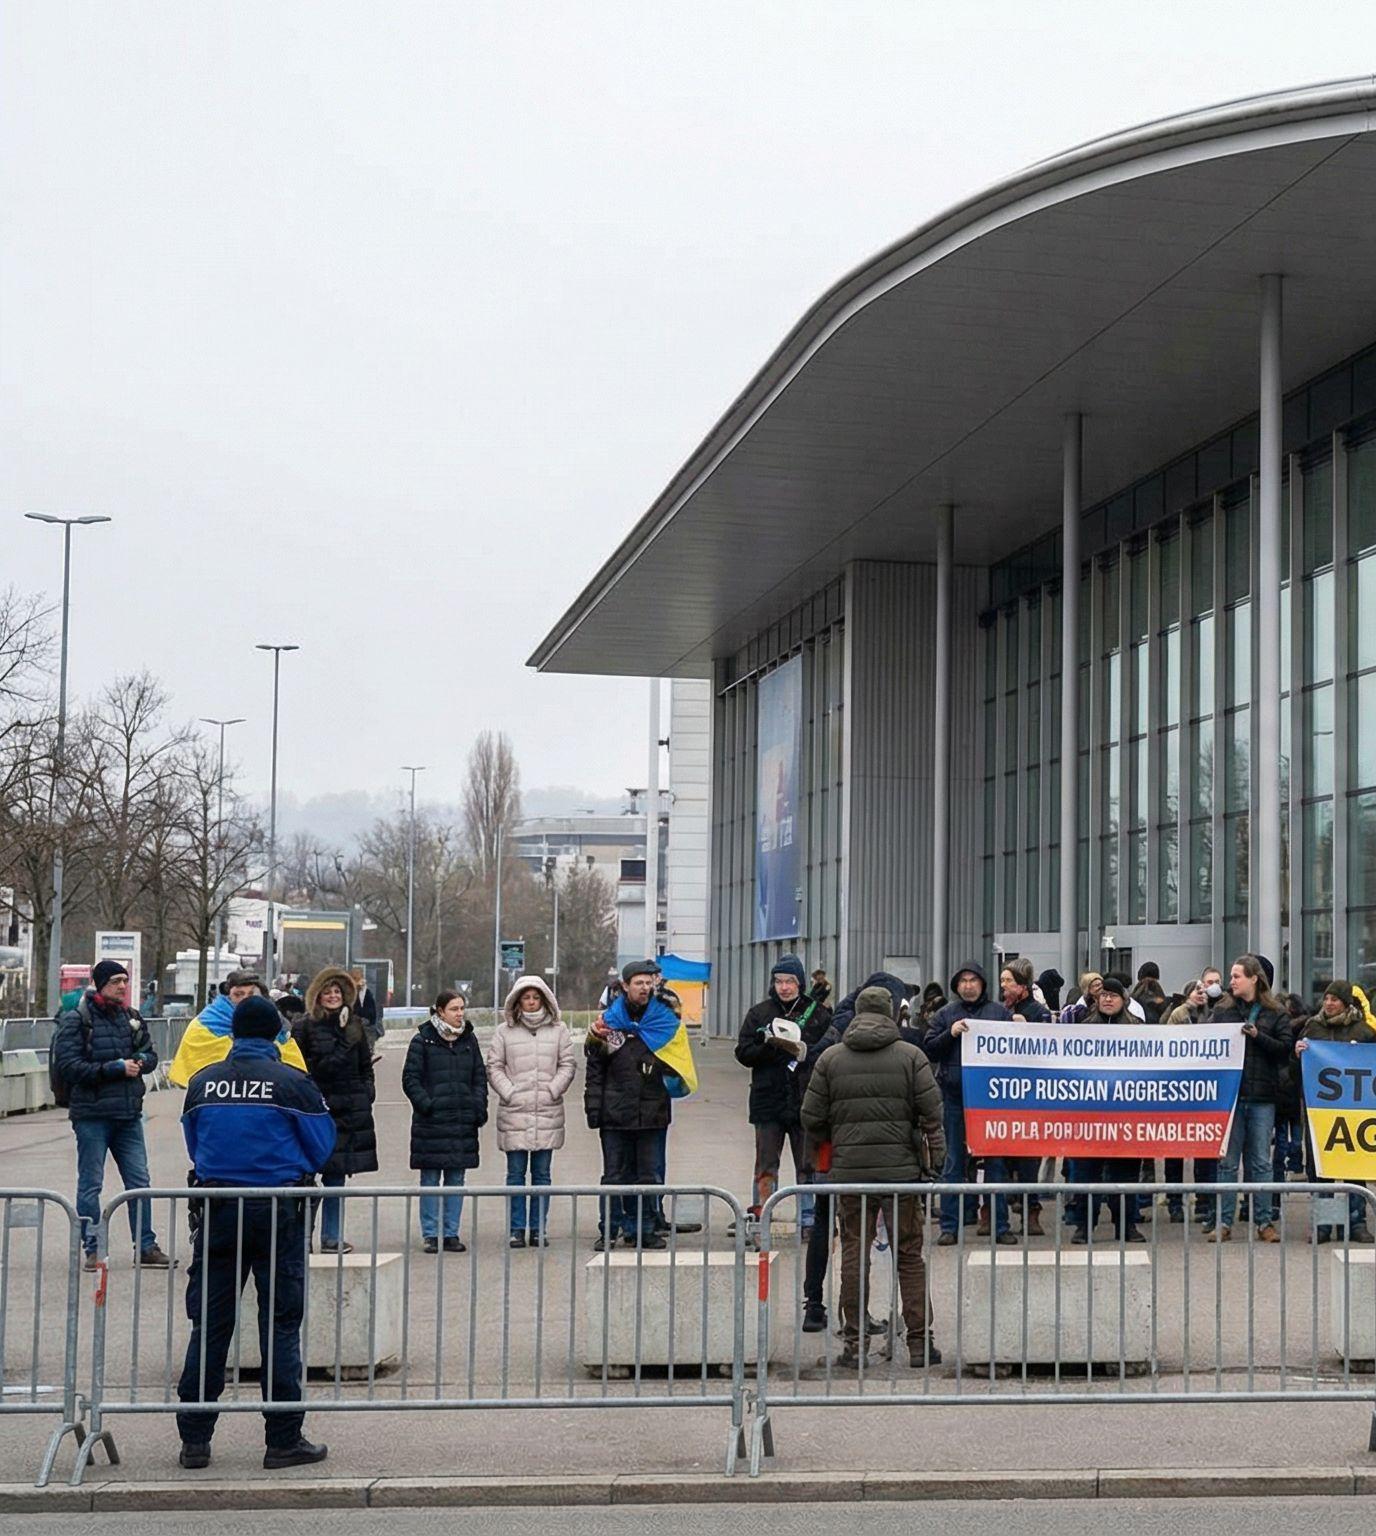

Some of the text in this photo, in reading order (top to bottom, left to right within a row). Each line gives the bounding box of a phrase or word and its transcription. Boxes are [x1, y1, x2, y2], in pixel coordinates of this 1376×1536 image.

[204, 1080, 274, 1099] POLIZE
[988, 1077, 1218, 1102] STOP RUSSIAN AGGRESSION
[985, 1120, 1007, 1139] NO
